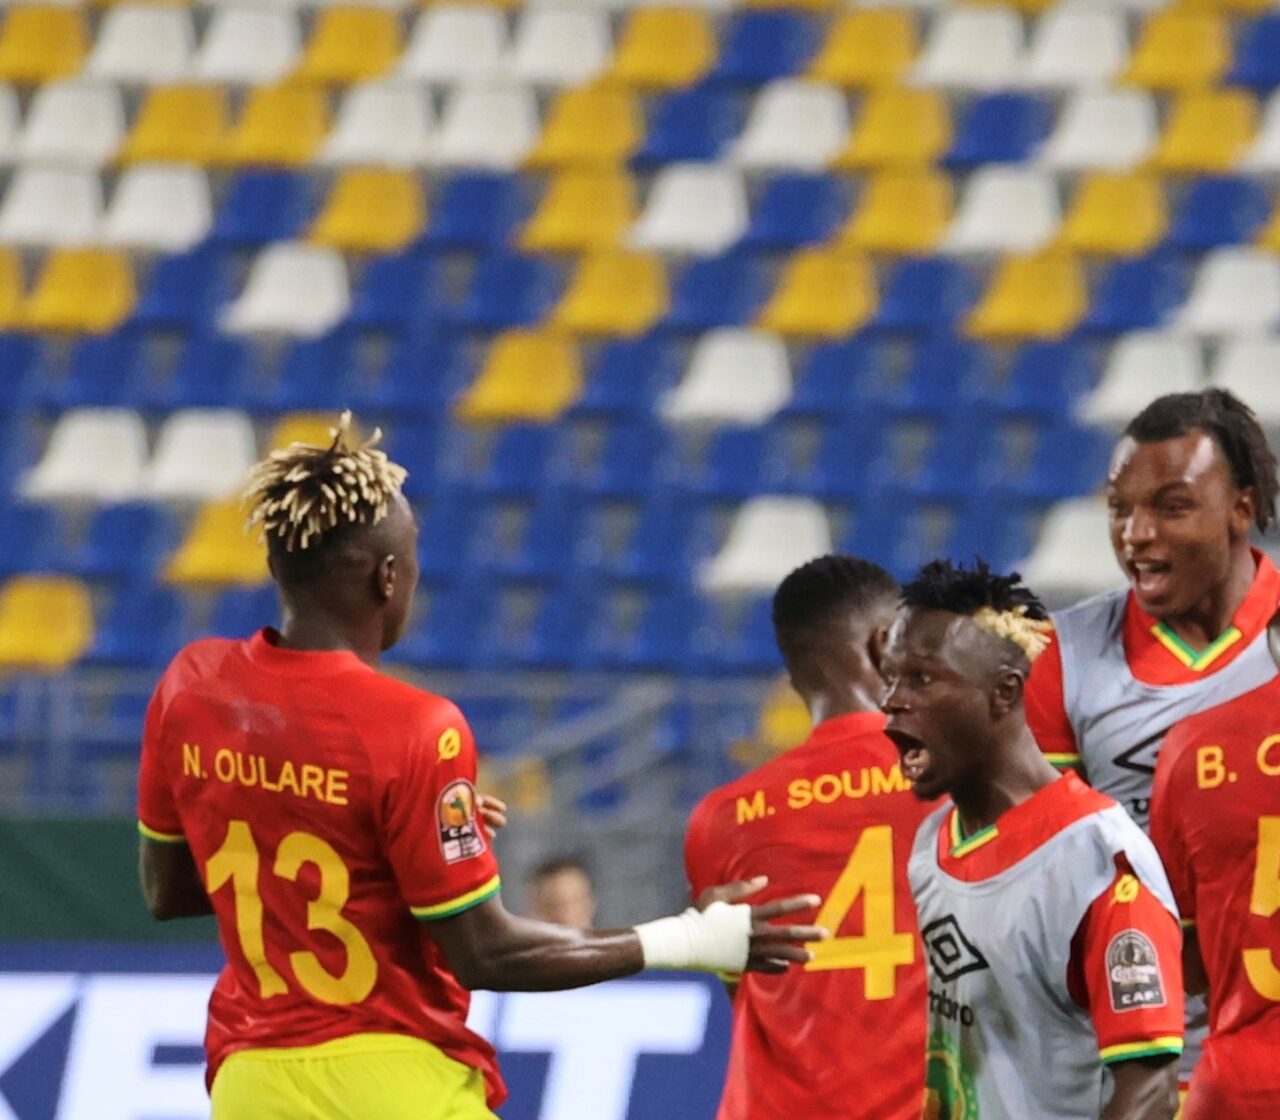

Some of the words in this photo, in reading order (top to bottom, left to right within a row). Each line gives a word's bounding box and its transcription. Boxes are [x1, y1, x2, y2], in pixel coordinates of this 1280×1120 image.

[182, 744, 209, 780] N.
[216, 749, 348, 806] OULARE
[736, 789, 776, 825] M.
[787, 763, 912, 809] SOUM
[1197, 745, 1238, 789] B.
[206, 819, 378, 1006] 13
[803, 825, 915, 1001] 4
